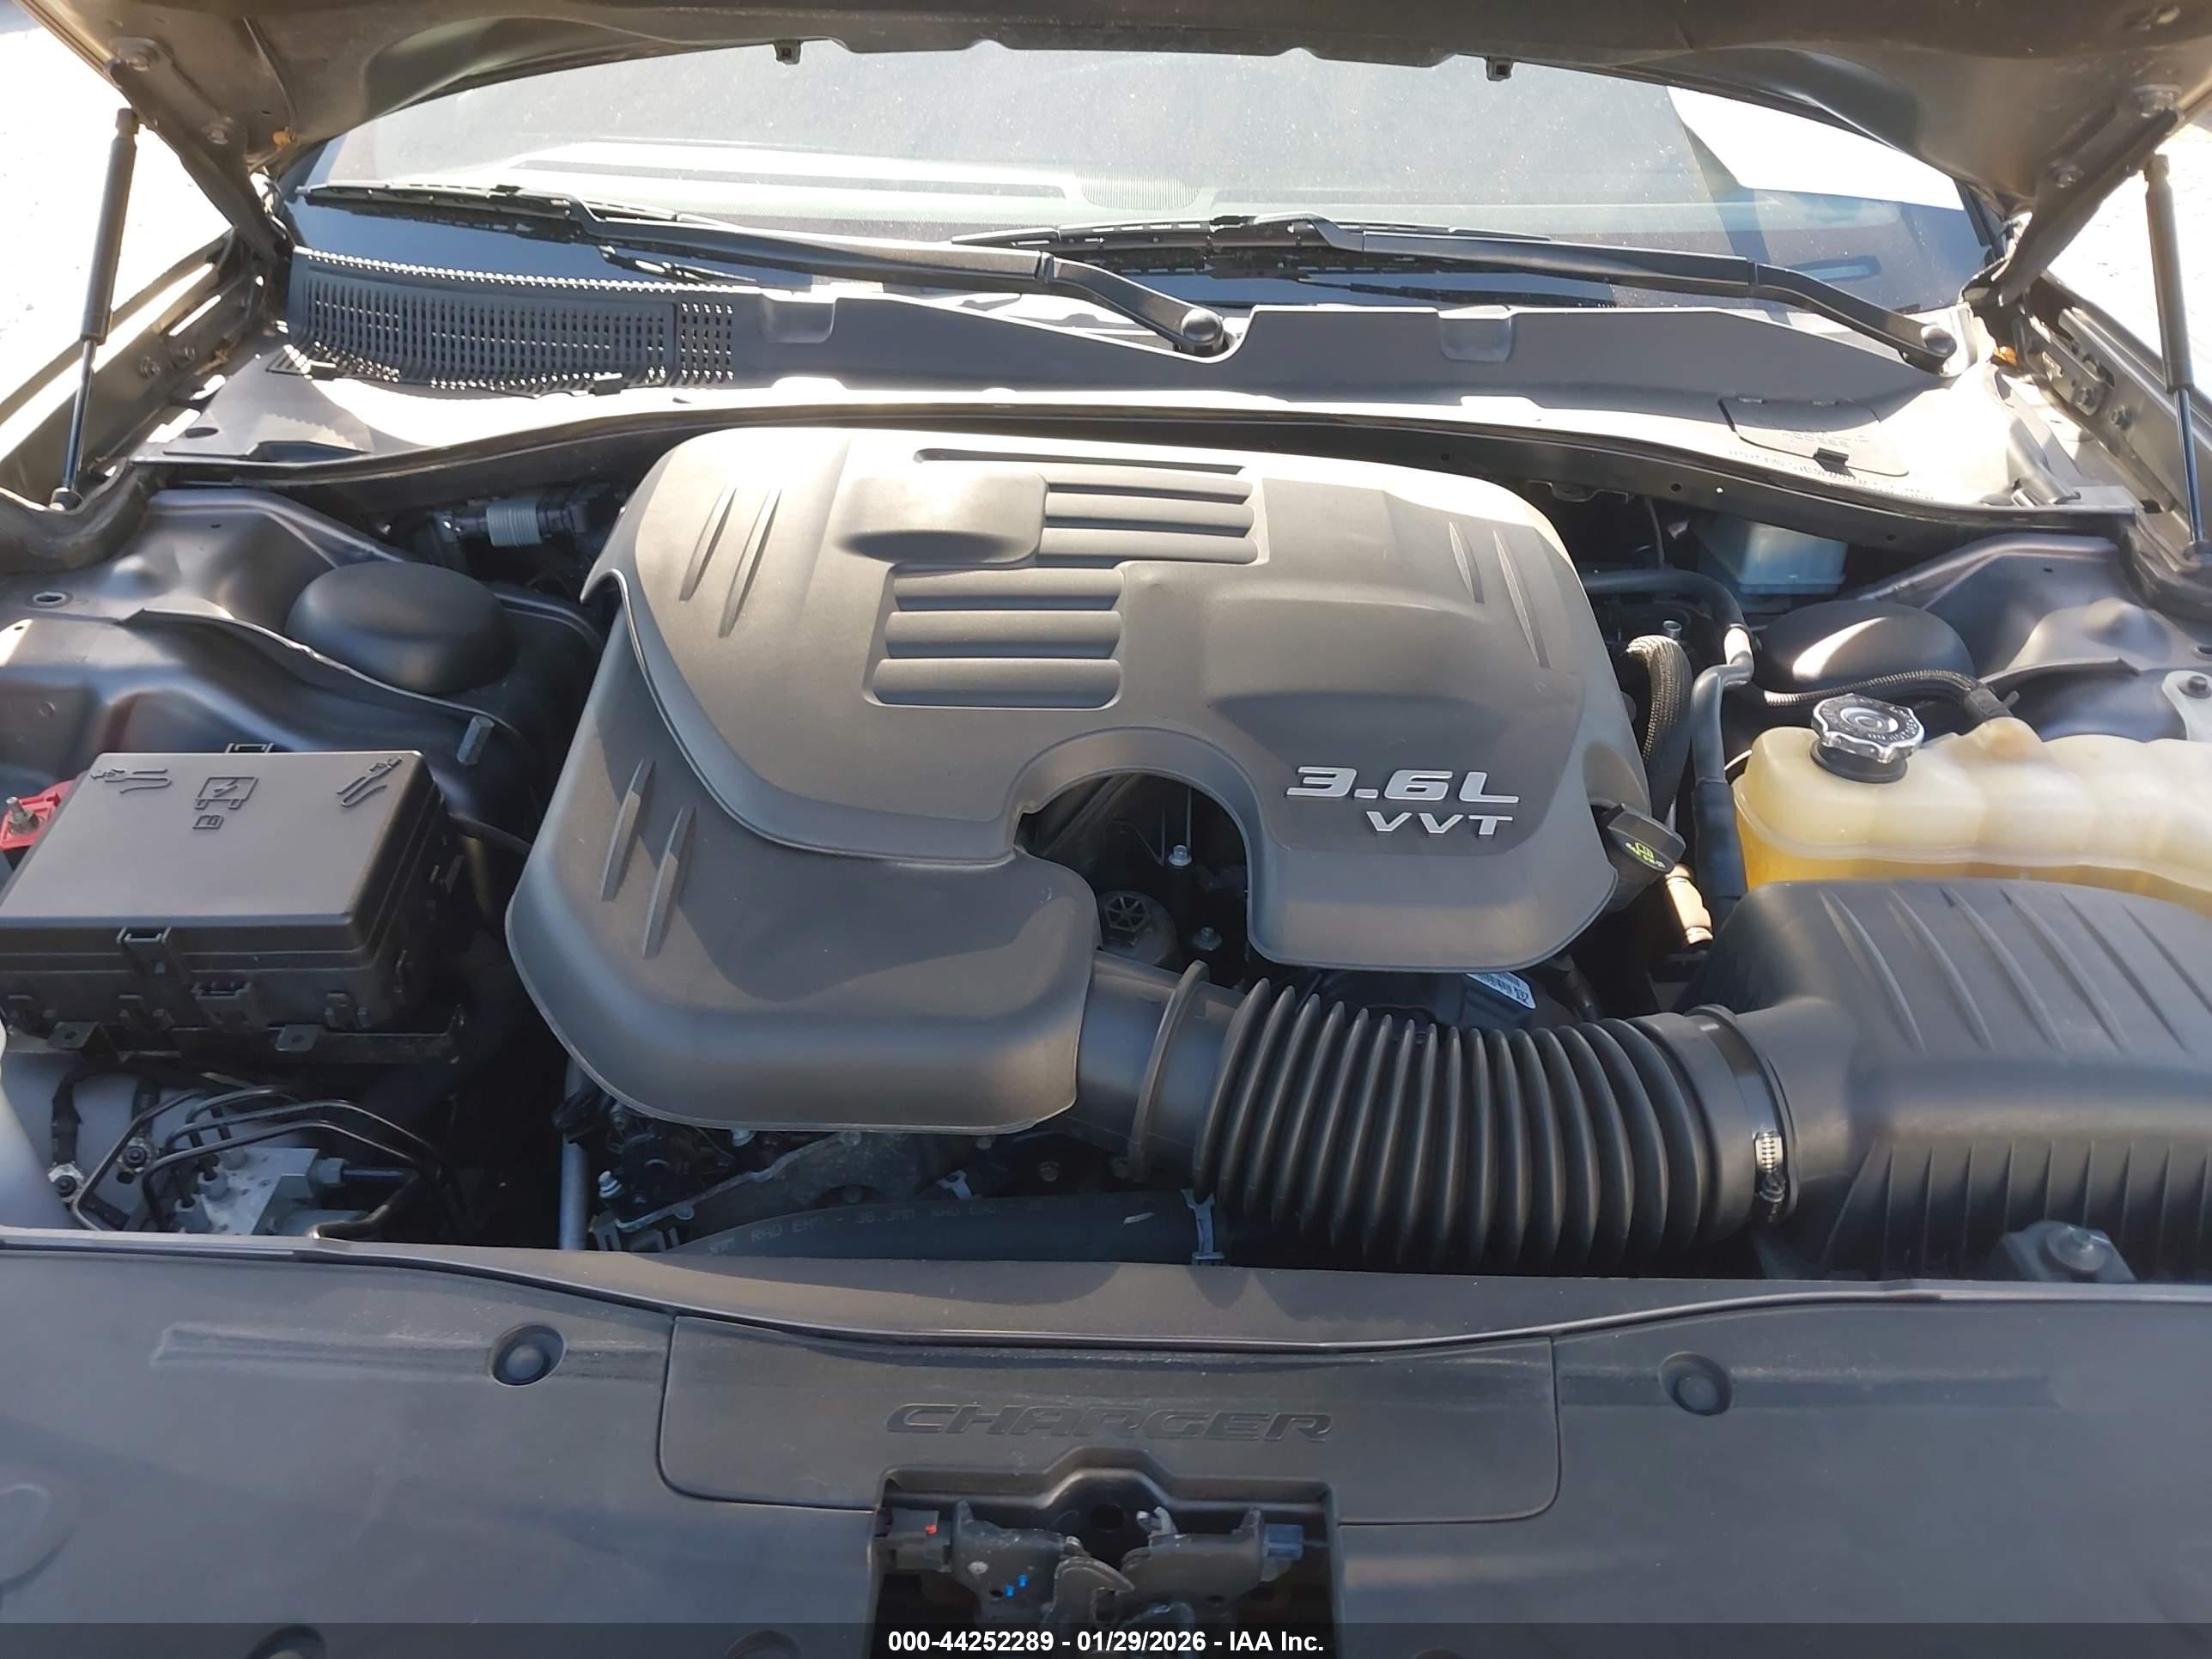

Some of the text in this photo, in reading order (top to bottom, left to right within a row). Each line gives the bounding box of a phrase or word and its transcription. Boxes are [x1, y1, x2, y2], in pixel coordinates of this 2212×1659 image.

[1286, 766, 1519, 804] 3.6L
[1366, 811, 1513, 836] VVT
[886, 1403, 1333, 1443] CHARGER
